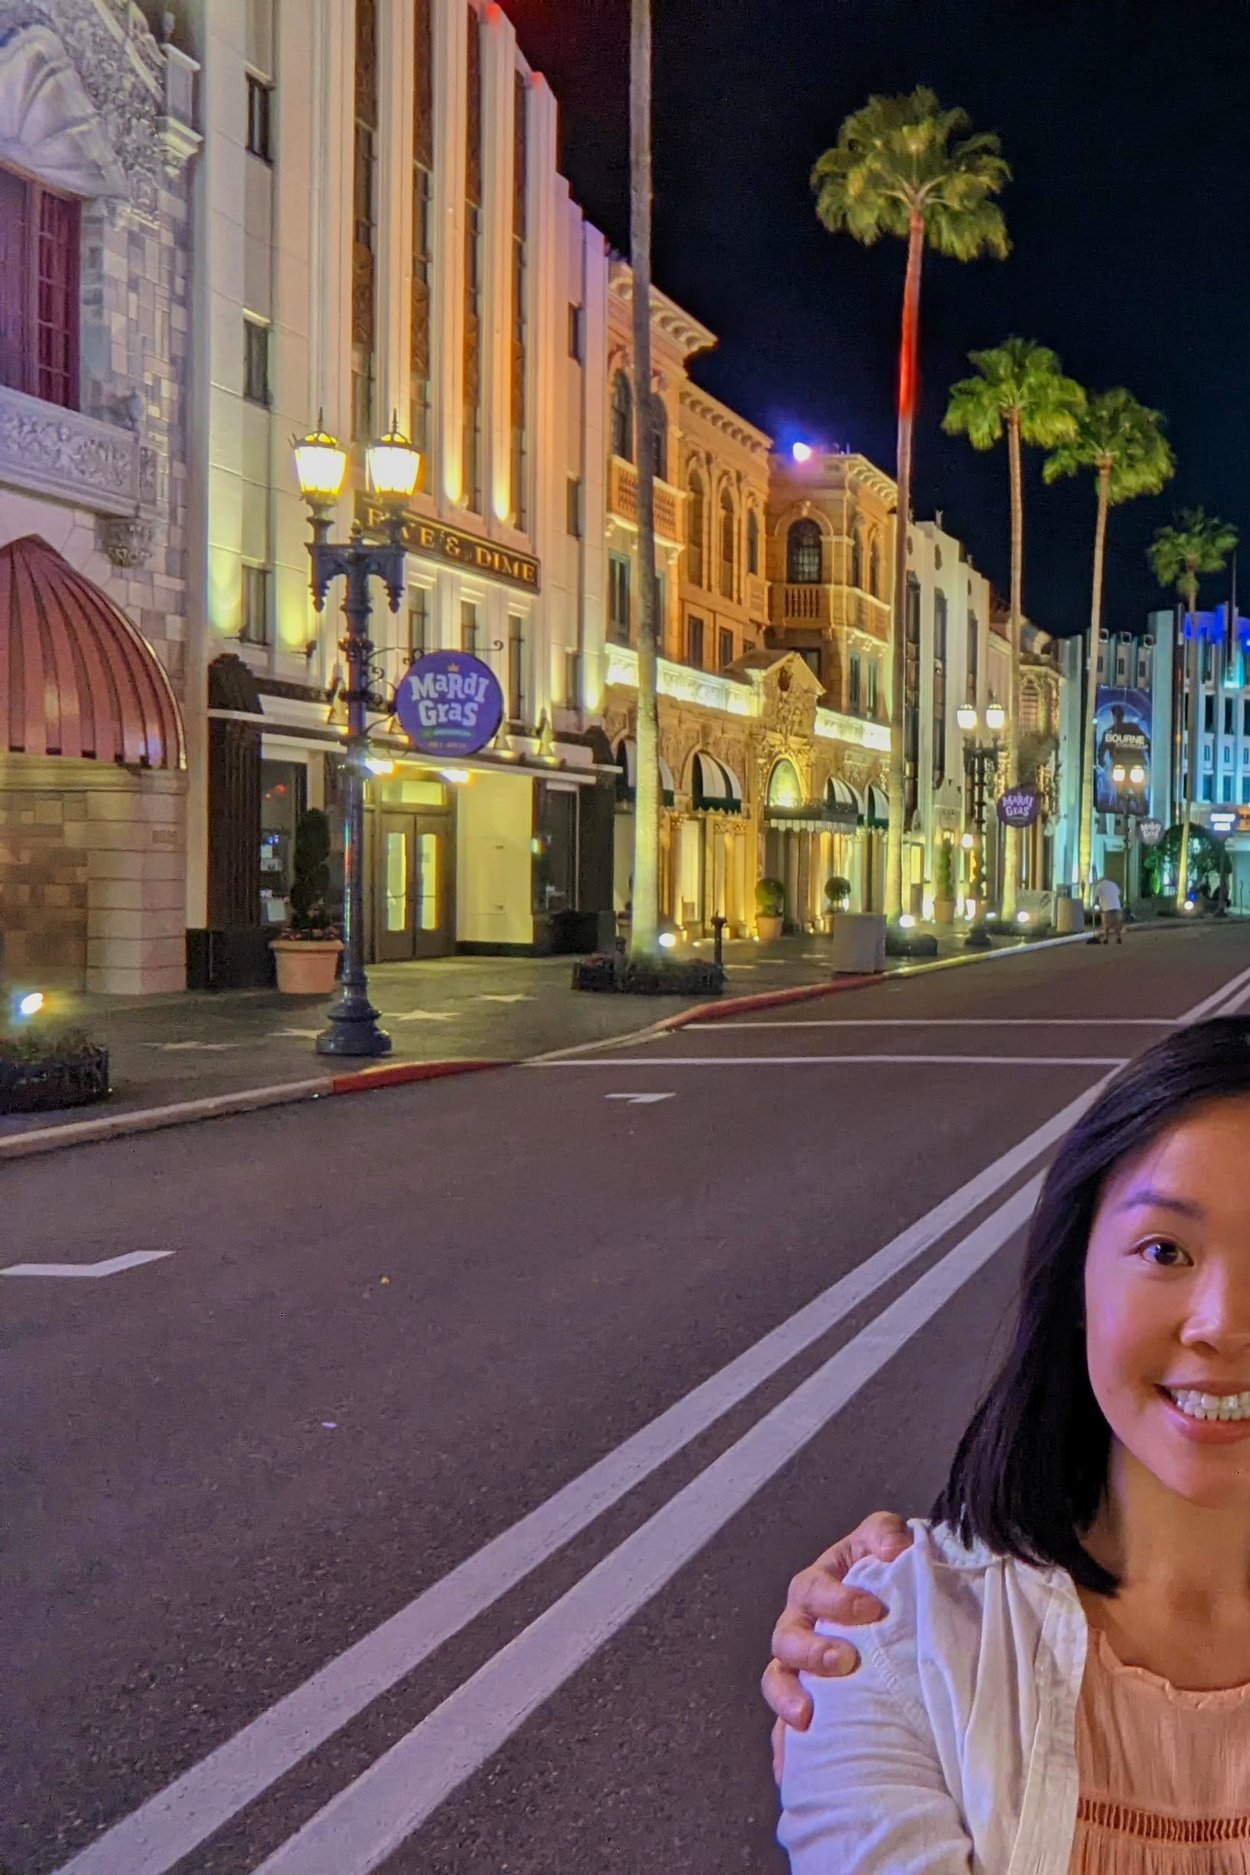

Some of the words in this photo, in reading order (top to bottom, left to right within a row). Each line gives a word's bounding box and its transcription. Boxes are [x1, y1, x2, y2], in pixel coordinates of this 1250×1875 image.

[367, 507, 435, 549] FVE
[446, 537, 460, 557] &
[476, 546, 536, 582] DIME
[1105, 733, 1145, 745] BOURNE
